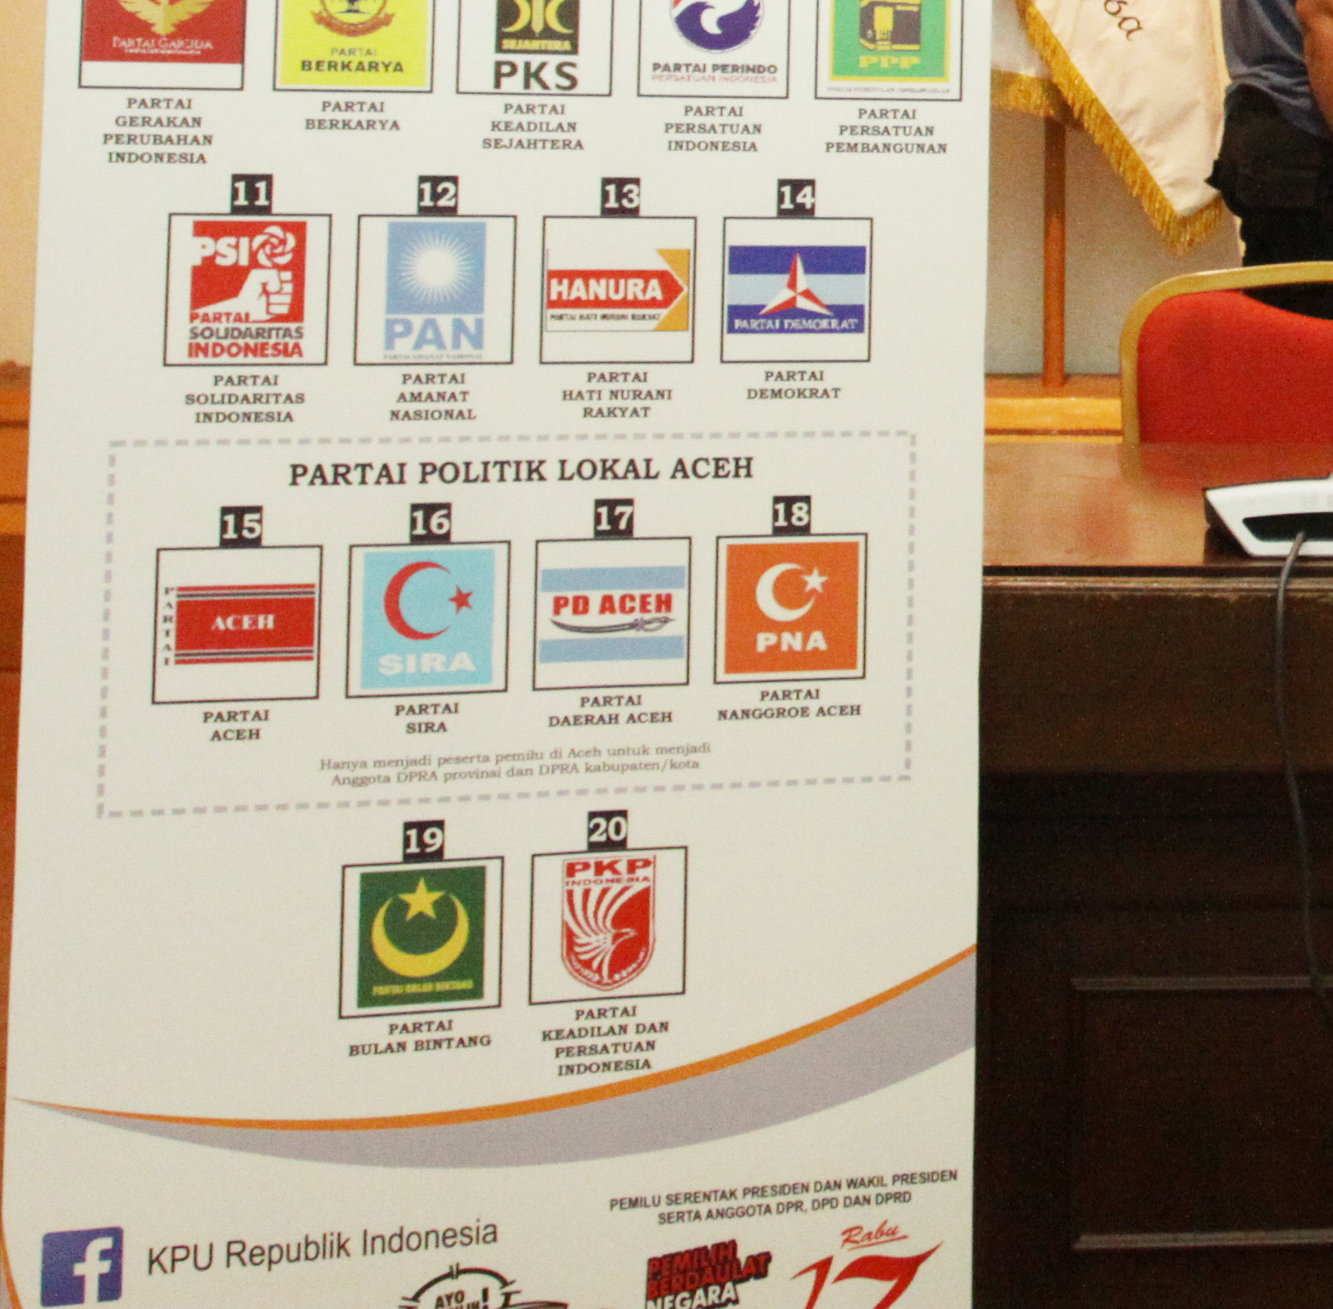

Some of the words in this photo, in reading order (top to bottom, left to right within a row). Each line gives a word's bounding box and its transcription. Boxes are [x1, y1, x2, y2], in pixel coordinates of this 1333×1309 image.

[300, 59, 404, 73] BERKARYA
[652, 62, 706, 73] PARTAI
[711, 63, 777, 74] PERINDO
[859, 55, 921, 69] PPP
[493, 60, 578, 91] PKS
[127, 97, 192, 110] PARTAI
[321, 100, 384, 113] PARTAI
[503, 103, 566, 115] PARTAI
[684, 105, 744, 117] PARTAI
[858, 108, 917, 120] PARTAI
[115, 115, 202, 128] GERAKAN
[305, 118, 400, 131] BERKARYA
[490, 120, 577, 133] KEADILAN
[664, 122, 762, 135] PERSATUAN
[839, 125, 934, 137] PERSATUAN
[102, 133, 213, 146] PERUBAHAN
[482, 138, 584, 151] SEJAHTERA
[667, 140, 758, 153] INDONESIA
[824, 142, 947, 154] PEMBANGUNAN
[107, 151, 207, 164] INDONESIA
[233, 181, 270, 206] 11
[419, 182, 457, 207] 12
[603, 183, 640, 209] 13
[778, 185, 816, 210] 14
[192, 236, 250, 266] PSI
[550, 277, 664, 301] HANURA
[189, 311, 251, 323] PARTAI
[733, 318, 780, 330] PARTAI
[783, 319, 858, 331] DEMOKRAT
[189, 326, 304, 340] SOLIDARITAS
[384, 318, 484, 351] PAN
[188, 341, 304, 358] INDONESIA
[213, 374, 279, 387] PARTAI
[401, 373, 466, 385] PARTAI
[586, 371, 648, 383] PARTAI
[764, 370, 824, 382] PARTAI
[185, 392, 305, 405] SOLIDARITAS
[397, 391, 470, 403] AMANAT
[562, 389, 602, 401] HATI
[609, 389, 673, 401] NURANI
[747, 387, 841, 400] DEMOKRAT
[195, 410, 294, 423] INDONESIA
[389, 408, 477, 421] NASIONAL
[582, 406, 651, 419] RAKYAT
[289, 462, 407, 487] PARTAI
[419, 459, 547, 485] POLITIK
[557, 457, 660, 482] LOKAL
[670, 456, 754, 480] ACEH
[596, 505, 634, 531] 17
[774, 502, 810, 527] 18
[222, 513, 262, 540] 15
[411, 509, 451, 536] 16
[552, 594, 590, 617] PD
[599, 592, 673, 615] ACEH
[210, 614, 276, 631] ACEH
[756, 630, 827, 653] PNA
[377, 652, 476, 676] SIRA
[580, 694, 642, 708] PARTAI
[759, 689, 821, 703] PARTAI
[202, 709, 270, 724] PARTAI
[394, 702, 459, 717] PARTAI
[717, 706, 810, 721] NANGGROE
[815, 703, 861, 717] ACEH
[548, 712, 619, 728] DAERAH
[625, 710, 672, 724] ACEH
[211, 727, 261, 741] ACEH
[406, 721, 447, 735] SIRA
[320, 758, 367, 772] Hanya
[373, 754, 432, 771] menjadi
[437, 753, 490, 768] peserta
[495, 749, 544, 766] pemilu
[568, 746, 601, 759] Aceh
[607, 744, 650, 757] untuk
[655, 742, 711, 757] menjadi
[331, 774, 391, 789] Anggota
[396, 771, 438, 783] DPRA
[507, 764, 533, 777] dan
[539, 764, 579, 776] DPRA
[585, 758, 699, 775] kabupaten/kota
[589, 817, 627, 842] 20
[405, 826, 443, 854] 19
[566, 858, 652, 878] PKP
[575, 1005, 637, 1020] PARTAI
[388, 1020, 453, 1035] PARTAI
[542, 1023, 628, 1041] KEADILAN
[633, 1021, 670, 1034] DAN
[348, 1041, 408, 1057] BULAN
[414, 1034, 491, 1051] BINTANG
[555, 1040, 656, 1058] PERSATUAN
[558, 1058, 652, 1076] INDONESIA
[609, 1196, 661, 1211] PEMILU
[665, 1188, 738, 1206] SERENTAK
[743, 1181, 810, 1199] PRESIDEN
[814, 1179, 842, 1192] DAN
[846, 1175, 888, 1190] WAKIL
[892, 1169, 958, 1186] PRESIDEN
[658, 1209, 702, 1225] SERTA
[706, 1203, 772, 1221] ANGGOTA
[776, 1200, 807, 1215] DPR,
[811, 1197, 839, 1211] DPD
[843, 1194, 871, 1208] DAN
[875, 1190, 912, 1206] DPRD
[148, 1243, 214, 1276] KPU
[226, 1231, 351, 1272] Republik
[362, 1219, 497, 1257] Indonesia
